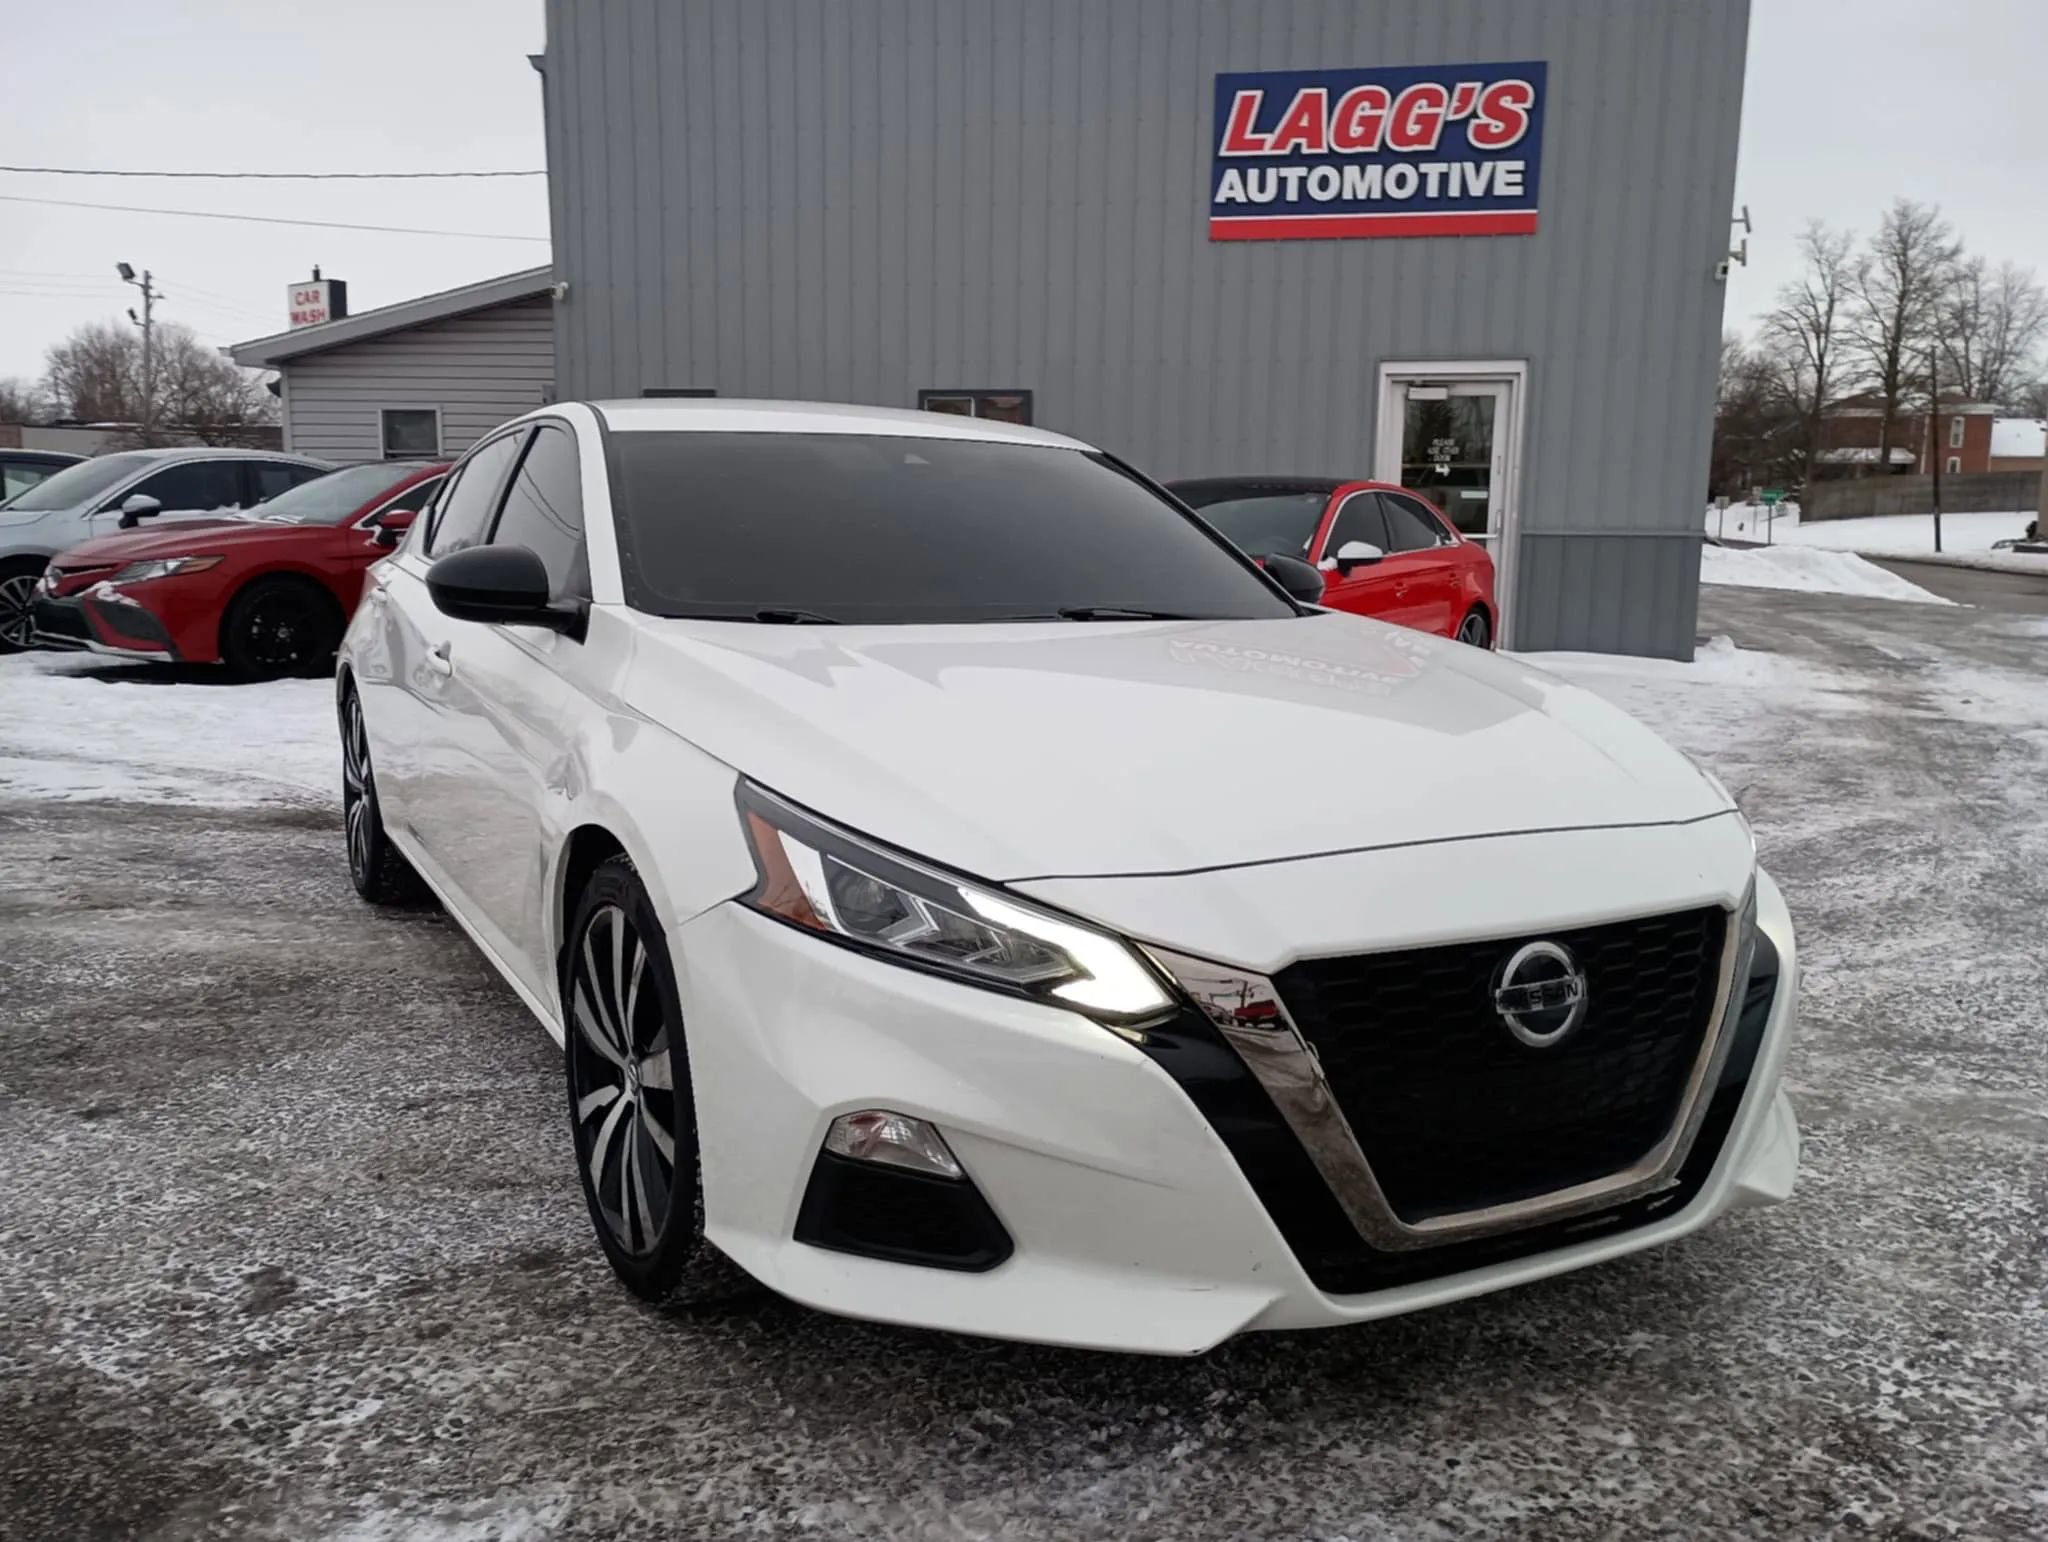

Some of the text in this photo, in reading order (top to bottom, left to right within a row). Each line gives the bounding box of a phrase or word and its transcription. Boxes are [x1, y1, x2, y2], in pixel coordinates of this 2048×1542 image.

[1219, 80, 1535, 156] LAGG'S
[1214, 160, 1526, 203] AUTOMOTIVE
[295, 290, 320, 306] CAR
[290, 309, 326, 326] WASH
